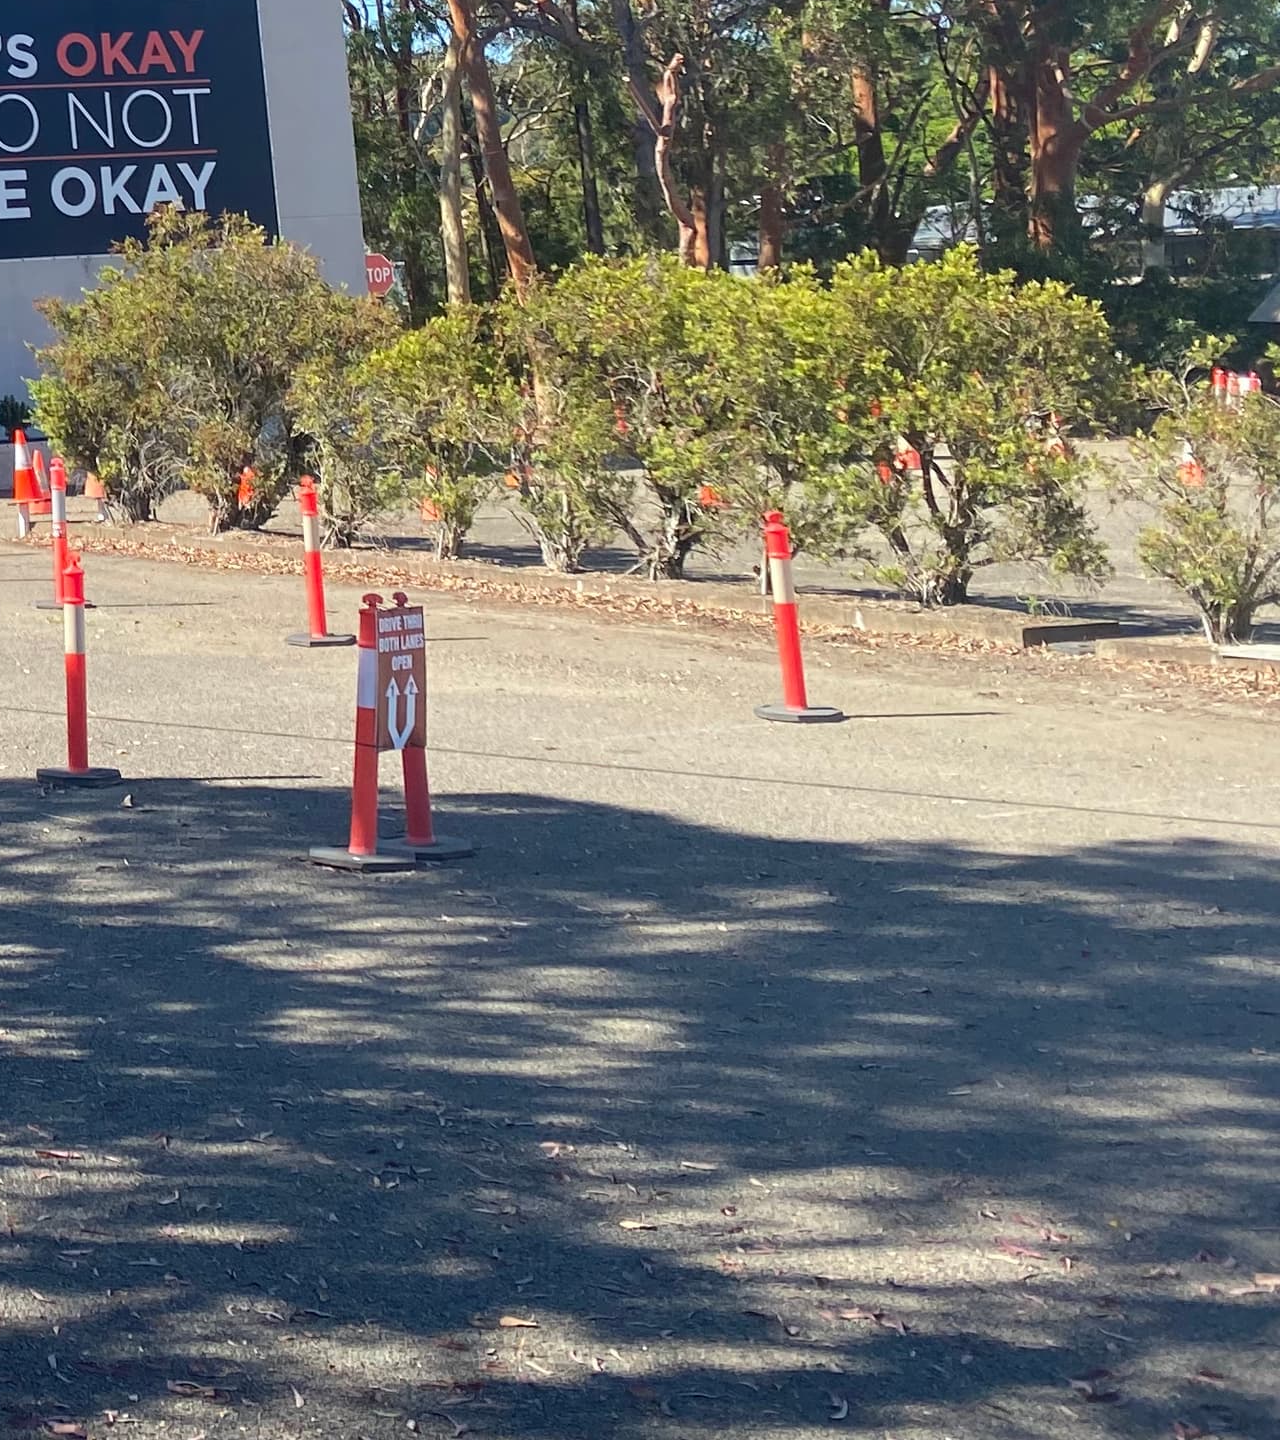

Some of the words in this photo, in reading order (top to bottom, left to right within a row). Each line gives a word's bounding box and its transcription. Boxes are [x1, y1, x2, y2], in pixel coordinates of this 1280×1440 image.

[56, 29, 205, 77] OKAY
[68, 88, 211, 150] NOT
[50, 161, 217, 217] OKAY
[366, 267, 390, 283] TOP
[379, 617, 401, 632] DRIVE
[379, 637, 399, 653] BOTH
[401, 634, 424, 650] LANES
[392, 655, 412, 671] OPEN
